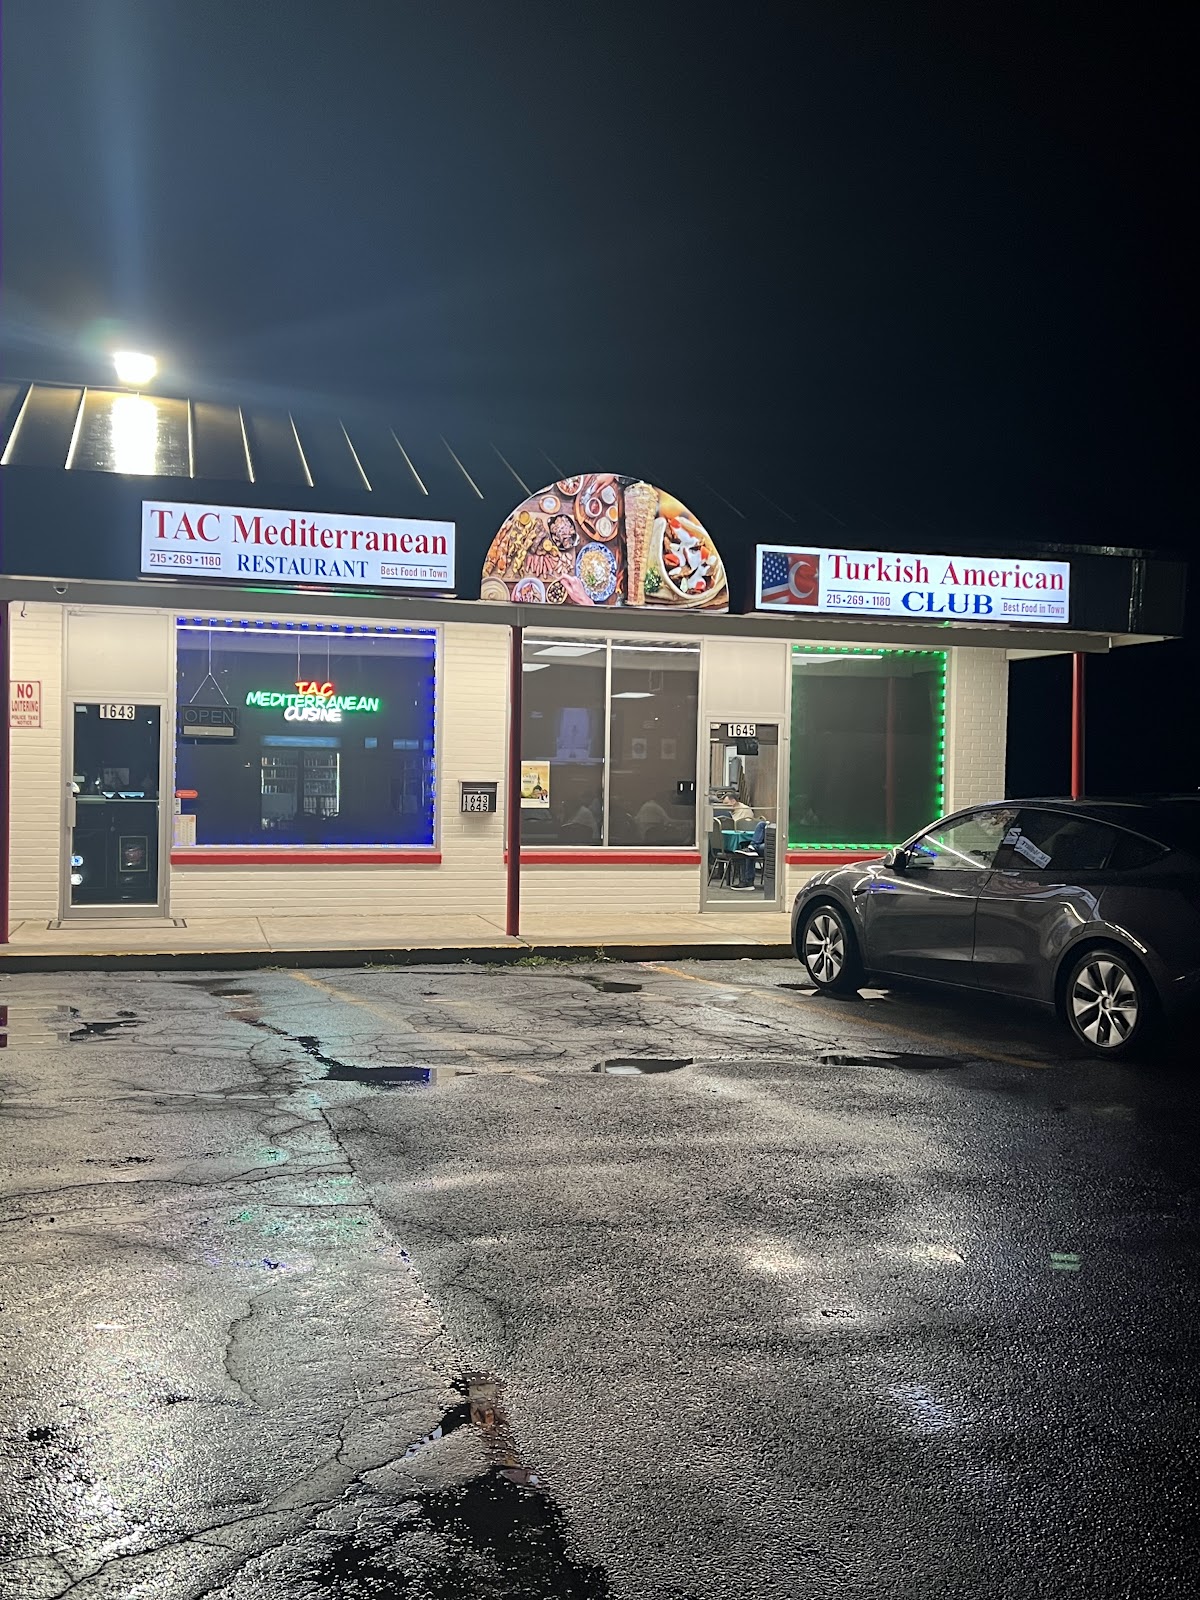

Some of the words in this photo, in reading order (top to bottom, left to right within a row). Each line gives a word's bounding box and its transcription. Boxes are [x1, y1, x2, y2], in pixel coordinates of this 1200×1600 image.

[150, 509, 221, 542] TAC
[231, 514, 448, 555] Mediterranean
[237, 553, 369, 579] RESTAURANT
[381, 566, 398, 576] Best
[400, 567, 418, 577] Food
[420, 568, 427, 578] in
[429, 569, 448, 579] Town
[828, 554, 930, 584] Turkish
[939, 560, 1065, 591] American
[901, 591, 993, 615] CLUB
[1003, 602, 1020, 613] Best
[1021, 603, 1038, 613] Food
[1039, 604, 1046, 613] in
[1047, 604, 1065, 614] Town
[17, 683, 33, 699] NO
[295, 682, 334, 697] TAC
[12, 700, 38, 712] LOITERING
[246, 691, 380, 712] MEDITERRANEAN
[102, 705, 134, 719] 1643
[184, 709, 235, 724] OPEN
[284, 706, 342, 722] CUISINE
[729, 724, 756, 737] 1645
[464, 795, 489, 804] 1643
[464, 803, 489, 812] 1645
